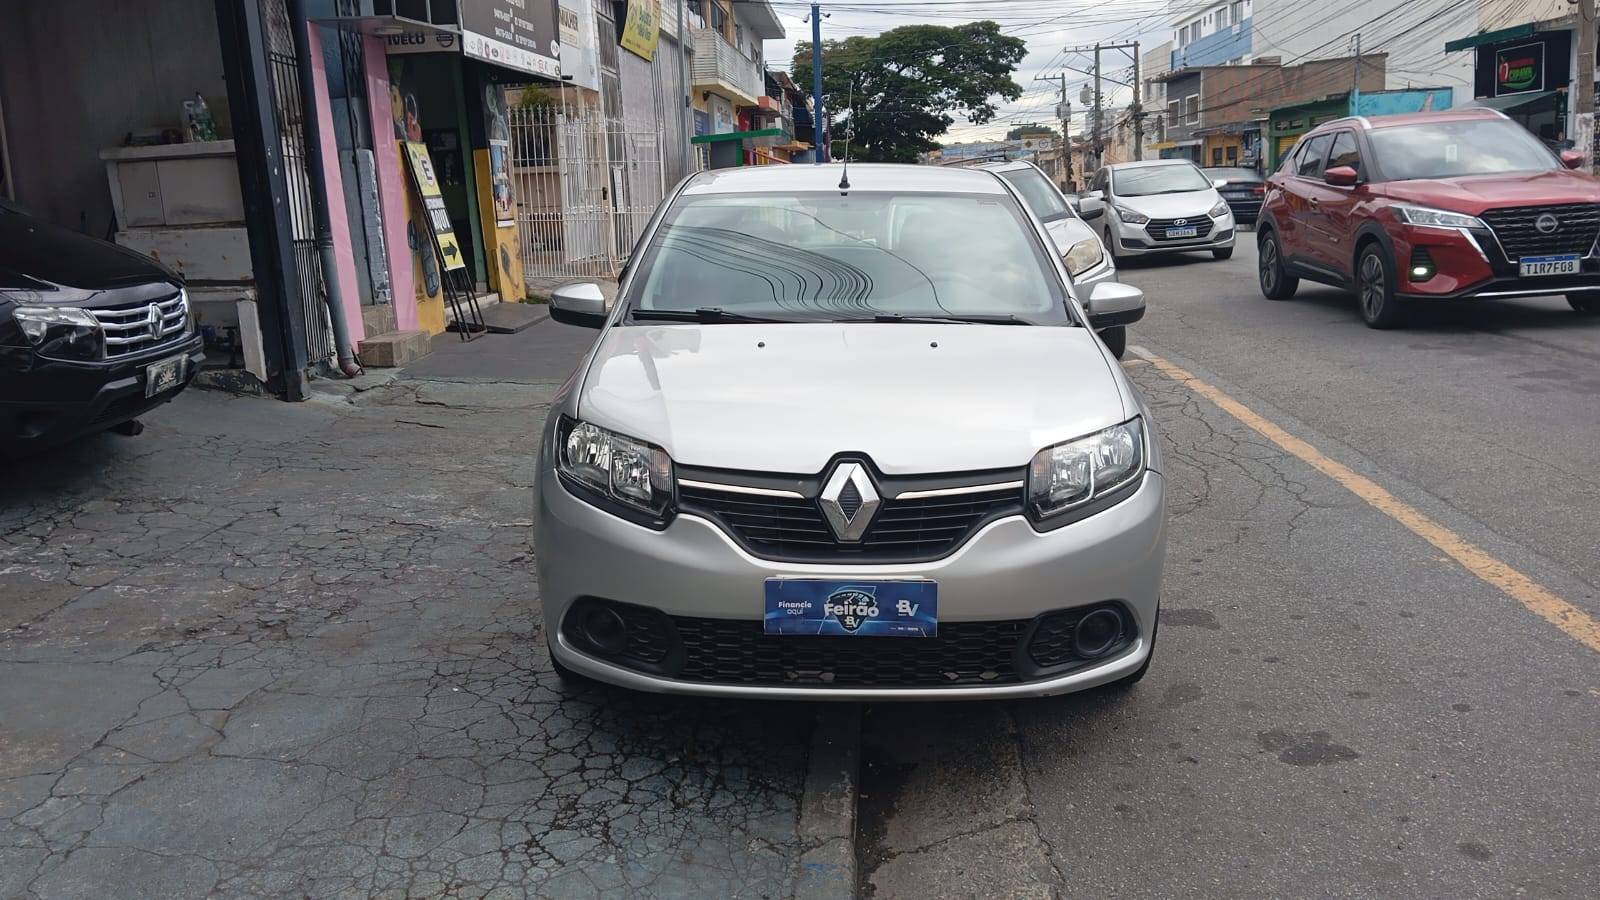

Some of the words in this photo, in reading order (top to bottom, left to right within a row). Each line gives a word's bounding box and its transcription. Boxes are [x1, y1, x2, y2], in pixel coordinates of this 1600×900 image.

[421, 158, 433, 181] E
[1526, 261, 1574, 274] TIR7F08
[824, 602, 879, 617] Feirão
[896, 600, 919, 617] BV
[845, 616, 859, 628] BV
